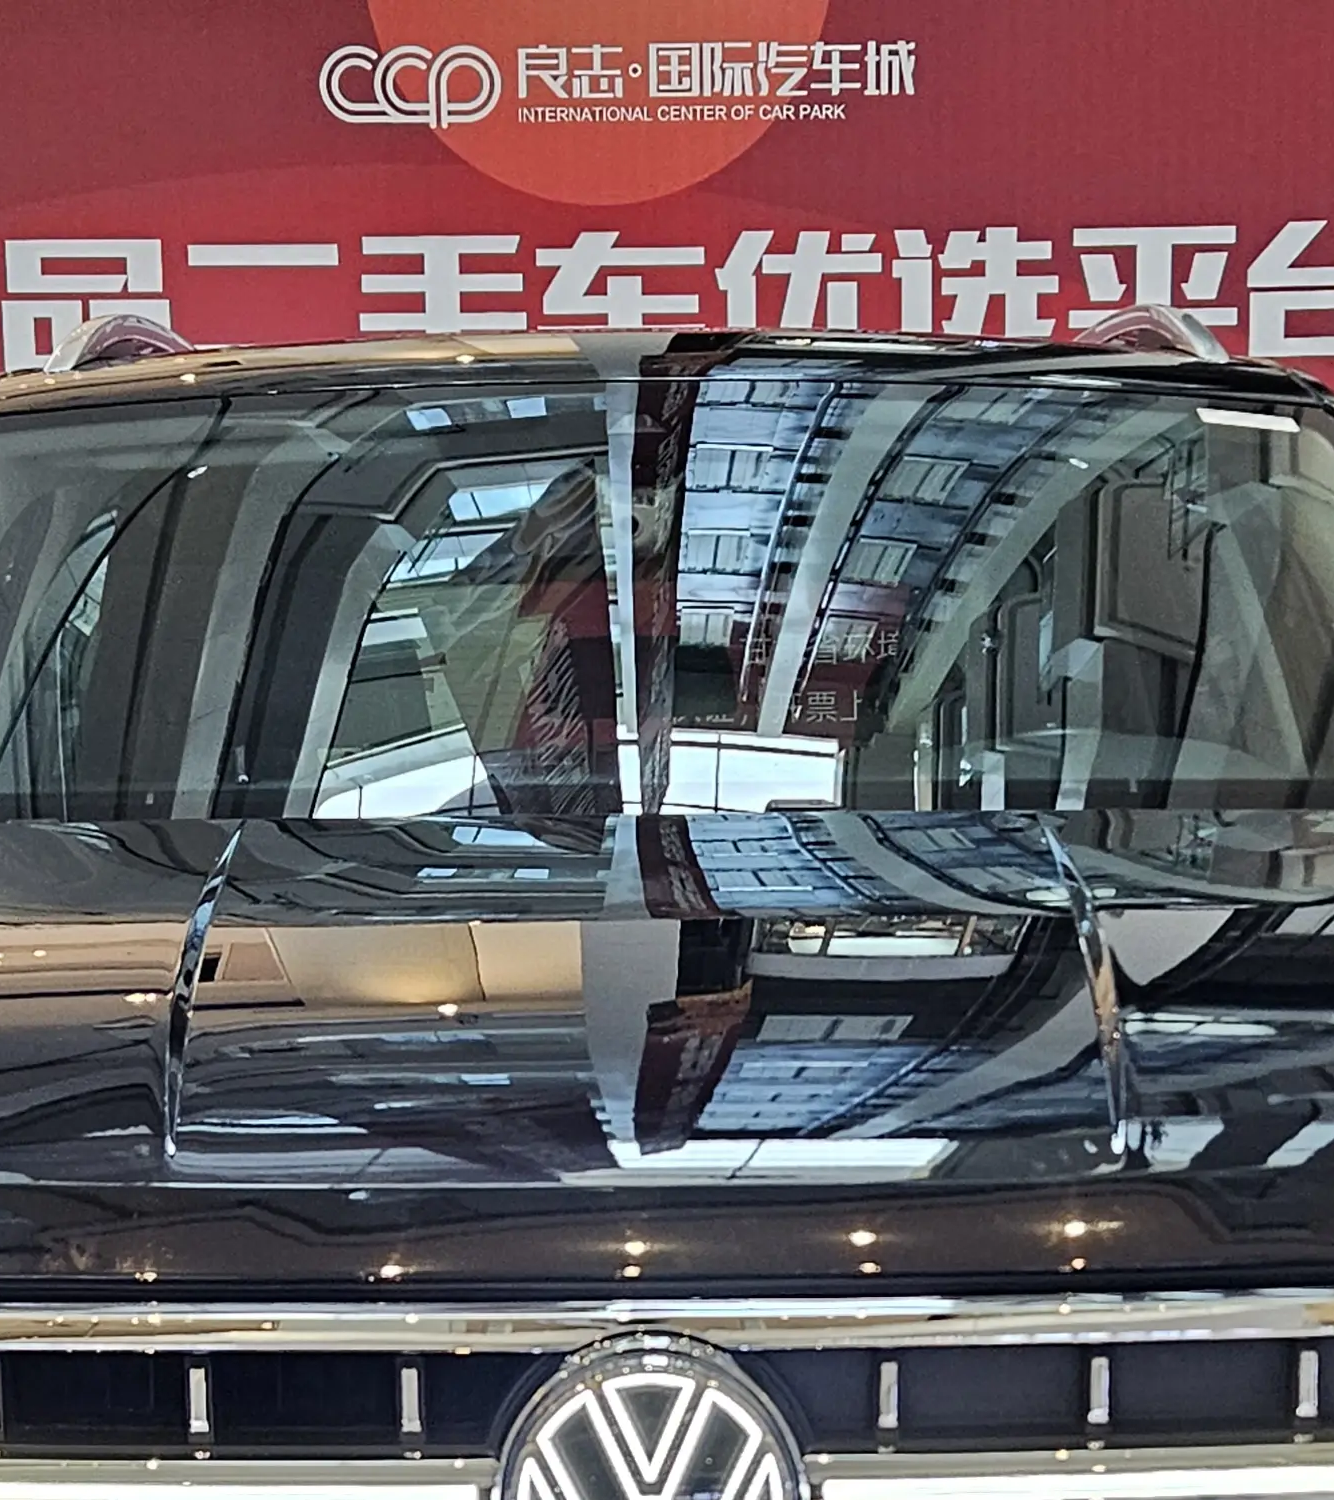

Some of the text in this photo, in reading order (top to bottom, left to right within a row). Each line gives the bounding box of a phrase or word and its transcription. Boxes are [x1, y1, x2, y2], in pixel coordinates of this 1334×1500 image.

[517, 104, 846, 122] INTERNATIONAL CENTER OF CAR PARK
